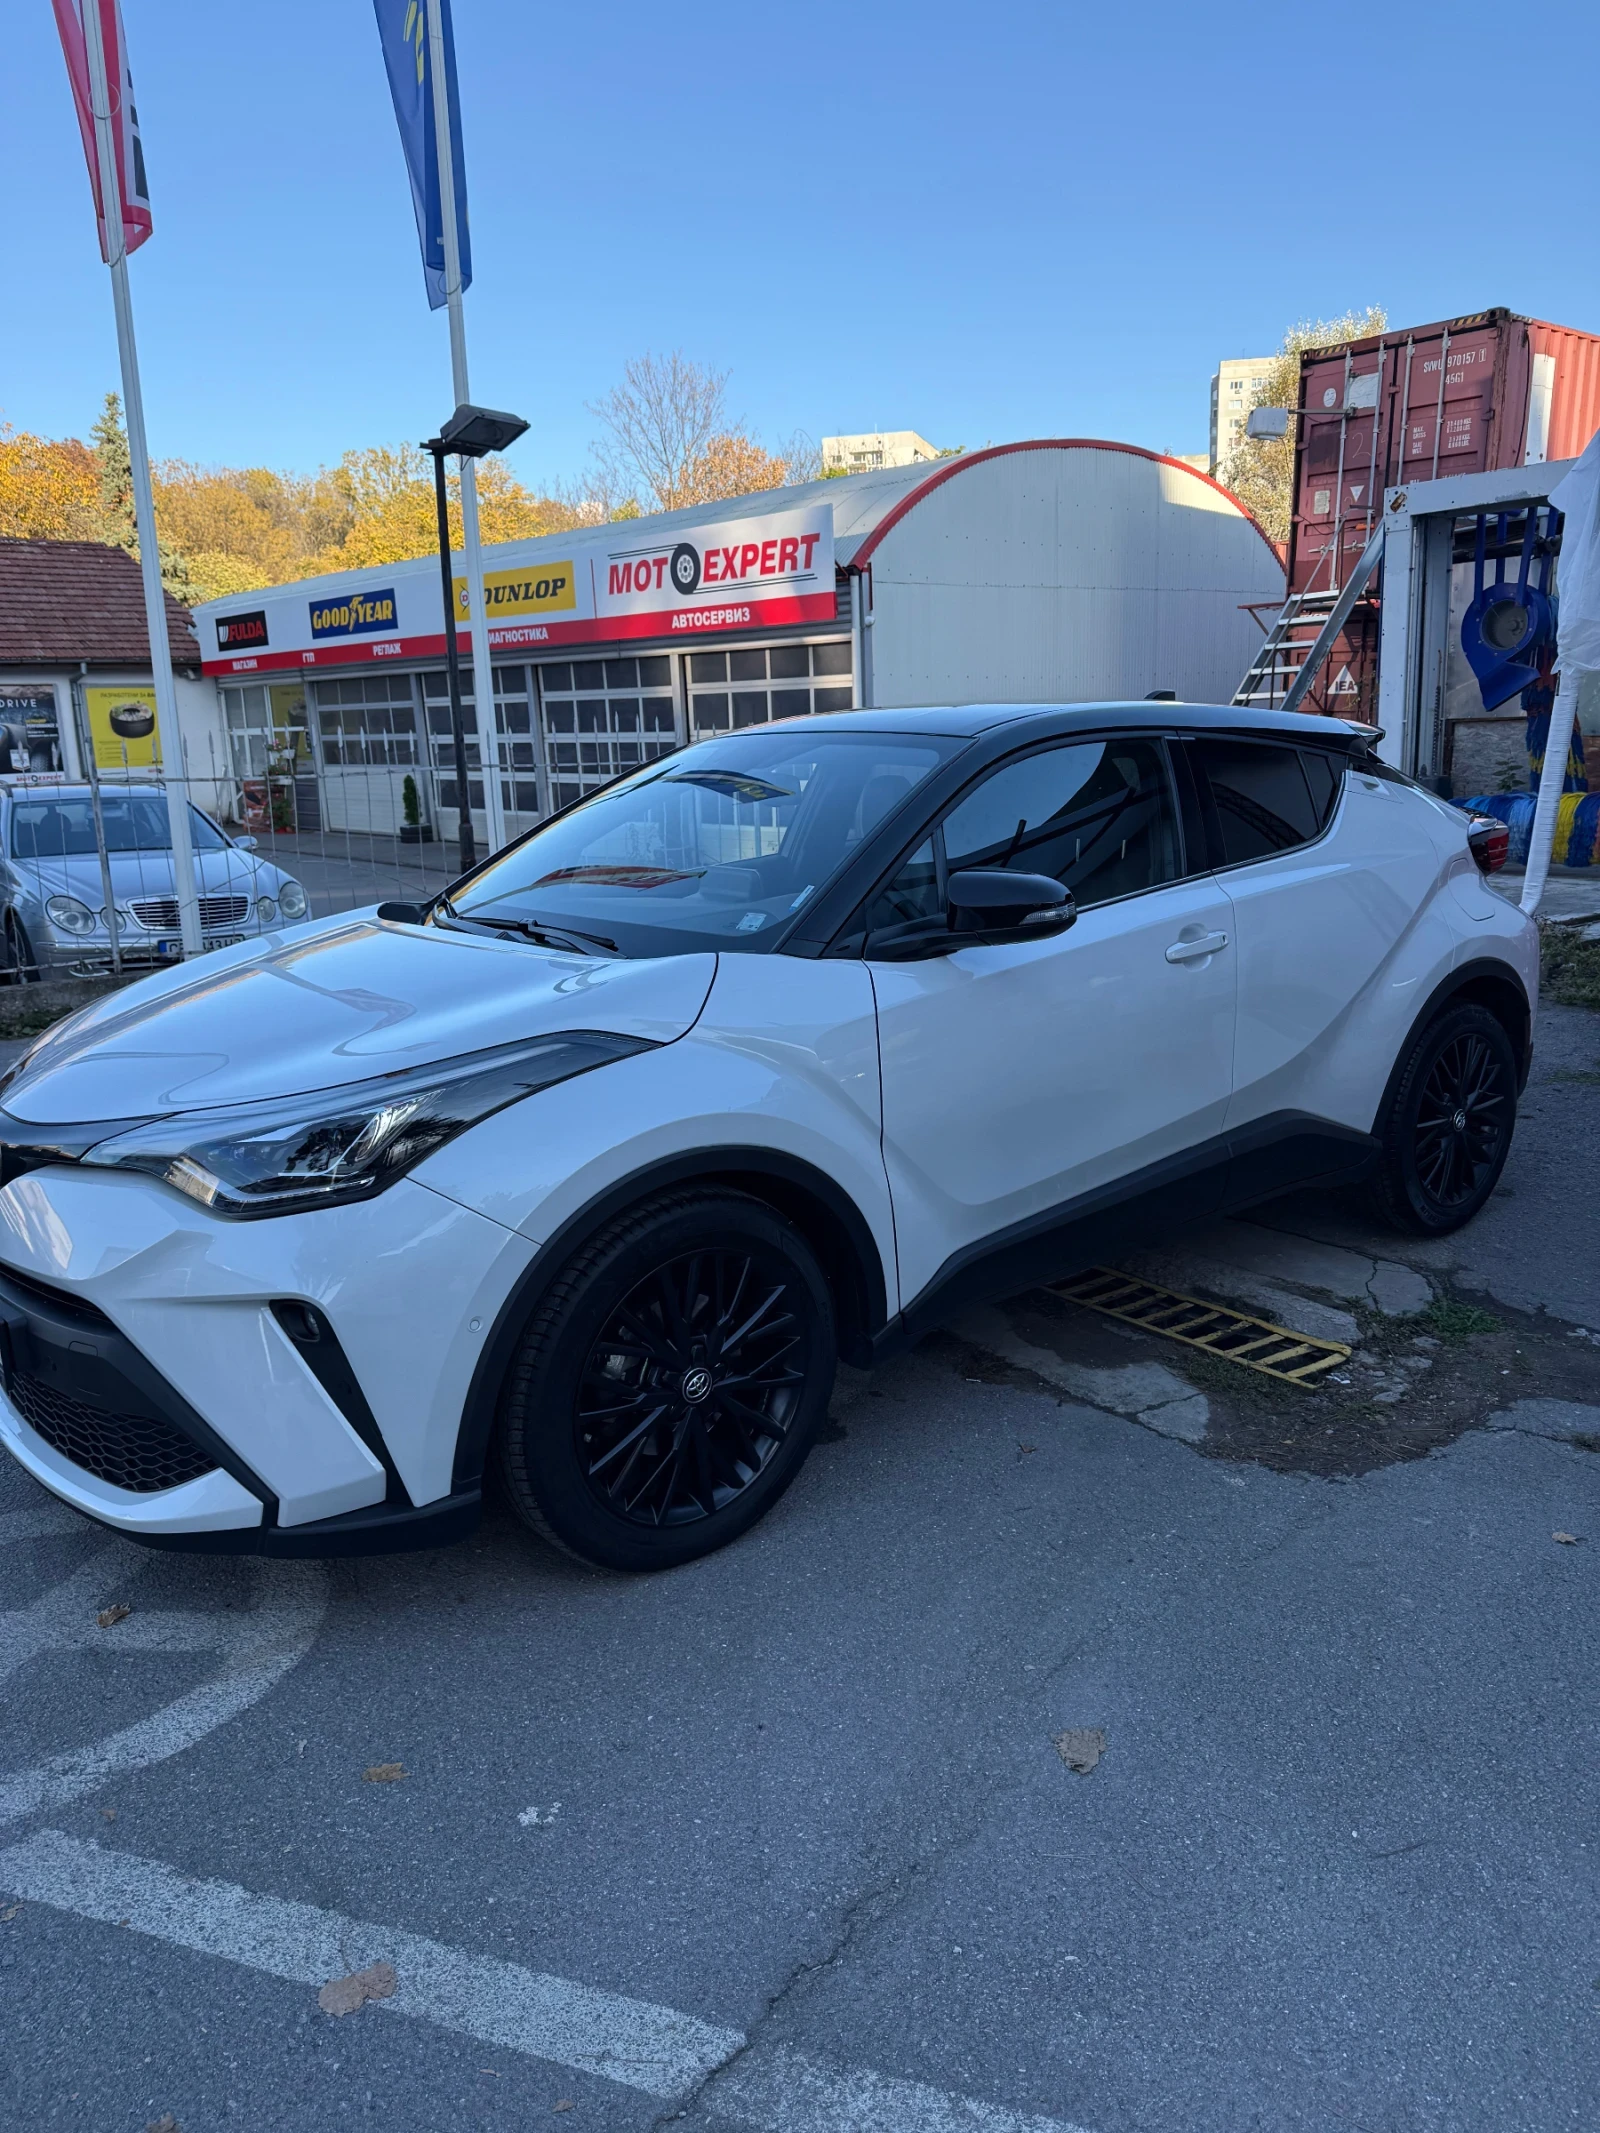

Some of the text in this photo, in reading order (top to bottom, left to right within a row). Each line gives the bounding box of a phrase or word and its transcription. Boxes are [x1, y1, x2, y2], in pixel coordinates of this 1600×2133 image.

[1447, 351, 1476, 367] 970157
[1445, 371, 1463, 384] 45G1
[671, 607, 751, 629] АВТОСЕРВИЗ
[228, 620, 265, 642] FULDA
[488, 626, 549, 644] ИАГНОСТИКА
[372, 643, 402, 656] РЕГЛАЖ
[302, 652, 315, 663] ГТП
[232, 659, 258, 671] МАГАЗИН
[1335, 680, 1355, 692] IEA
